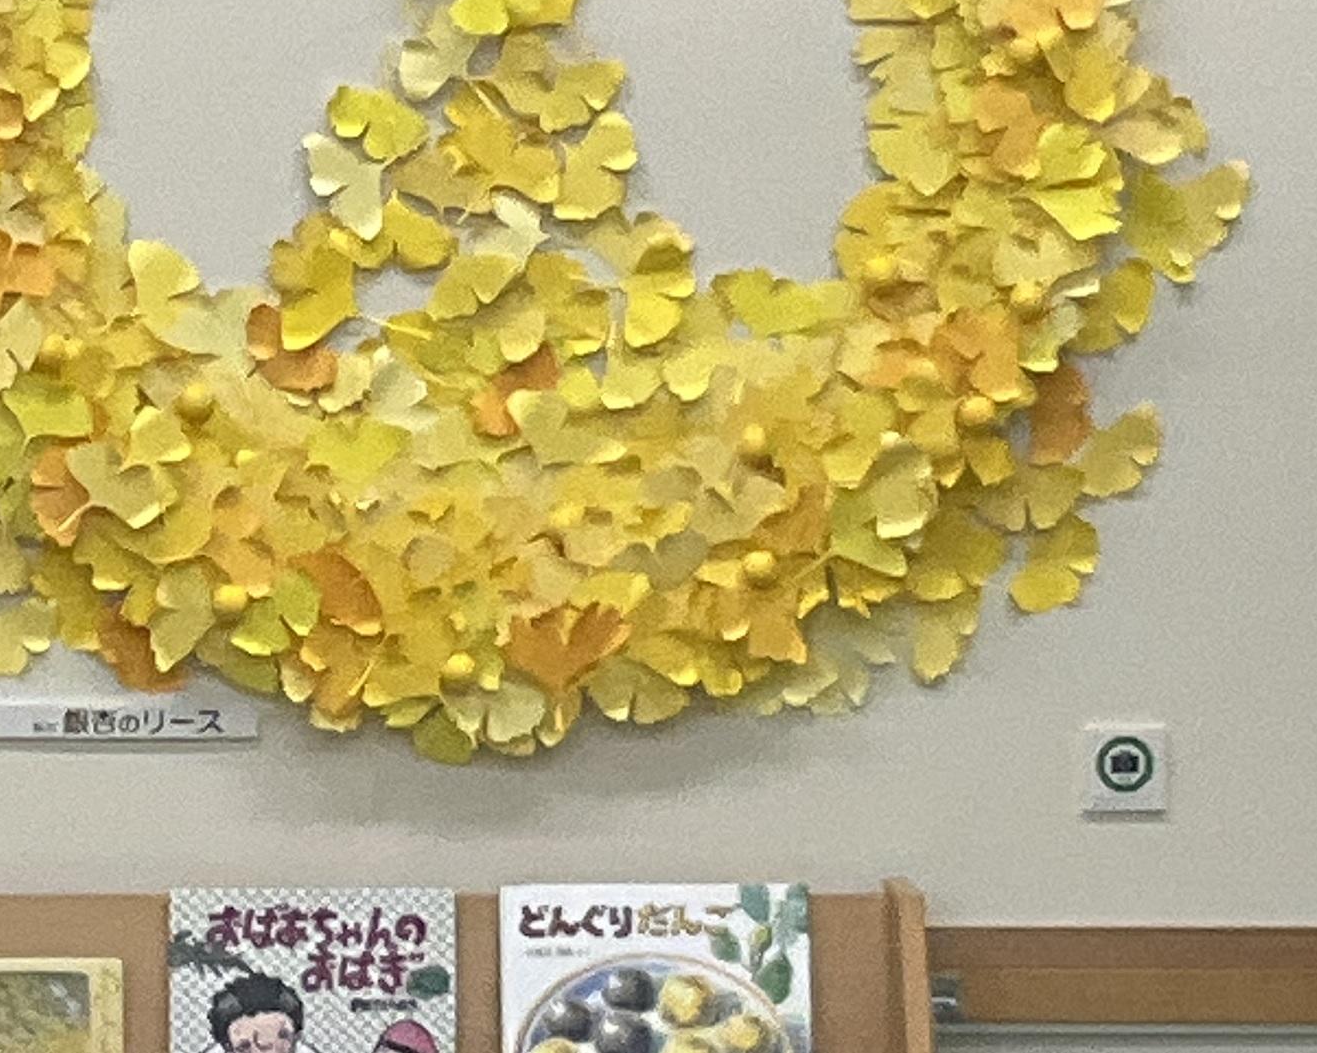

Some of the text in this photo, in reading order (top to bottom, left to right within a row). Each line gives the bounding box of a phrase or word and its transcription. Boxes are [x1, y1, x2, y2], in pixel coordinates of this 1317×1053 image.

[64, 708, 225, 735] 銀杏のリース
[205, 904, 428, 949] おばあちゃんの
[301, 945, 424, 995] おはぎ
